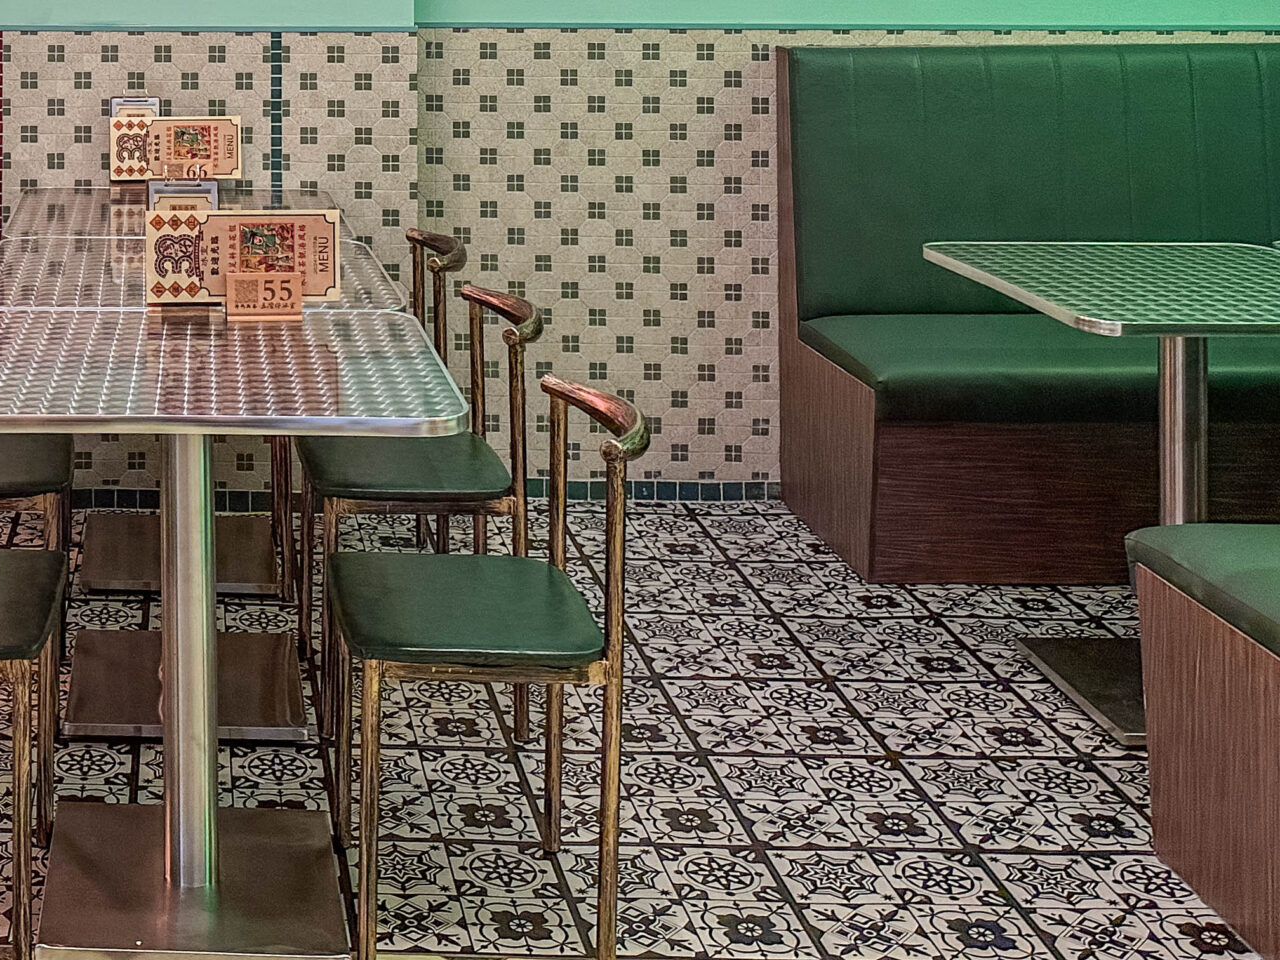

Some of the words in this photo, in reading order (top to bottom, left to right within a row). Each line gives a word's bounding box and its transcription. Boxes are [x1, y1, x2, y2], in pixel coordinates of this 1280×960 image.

[226, 134, 234, 159] MENU
[319, 236, 329, 273] MENU
[263, 279, 293, 301] 55
